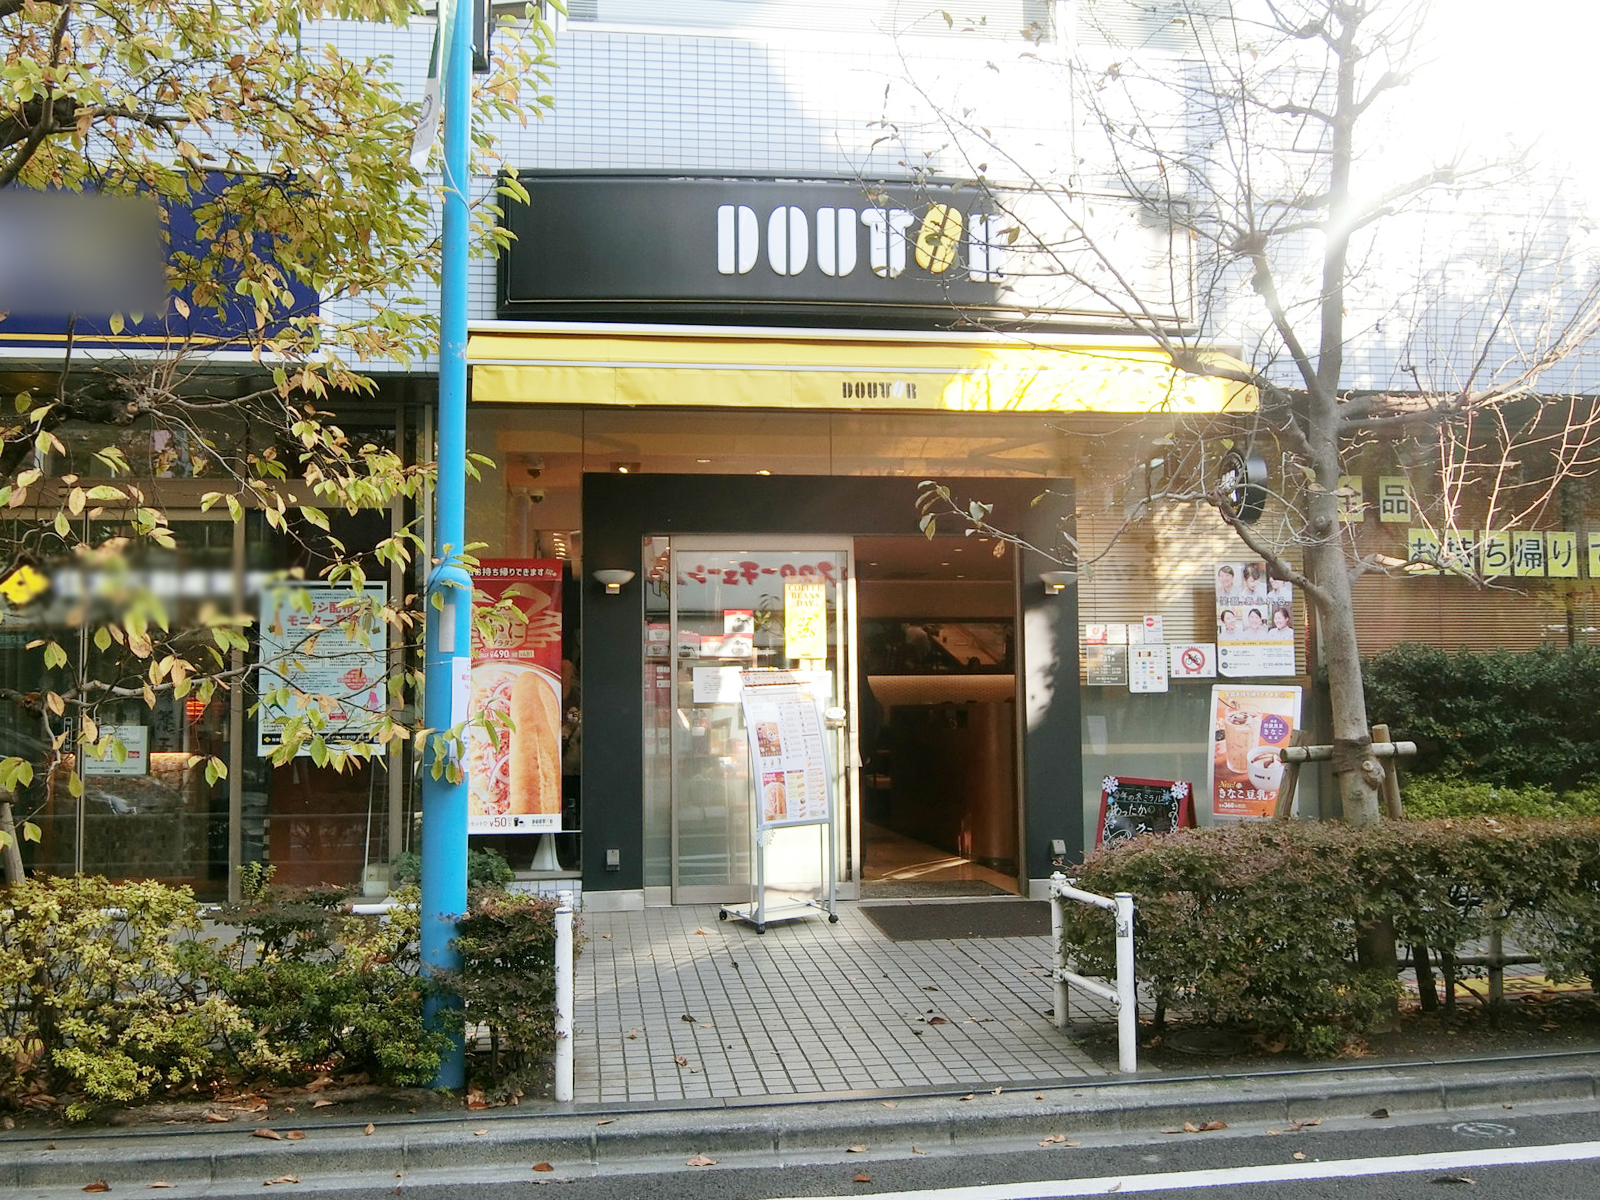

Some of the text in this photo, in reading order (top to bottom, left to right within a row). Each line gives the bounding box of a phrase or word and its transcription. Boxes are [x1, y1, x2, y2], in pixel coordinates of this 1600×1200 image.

[717, 203, 1006, 283] DOUTOR
[842, 379, 917, 399] DOUTOR
[788, 584, 823, 592] COFFEE
[791, 592, 820, 600] BEANS
